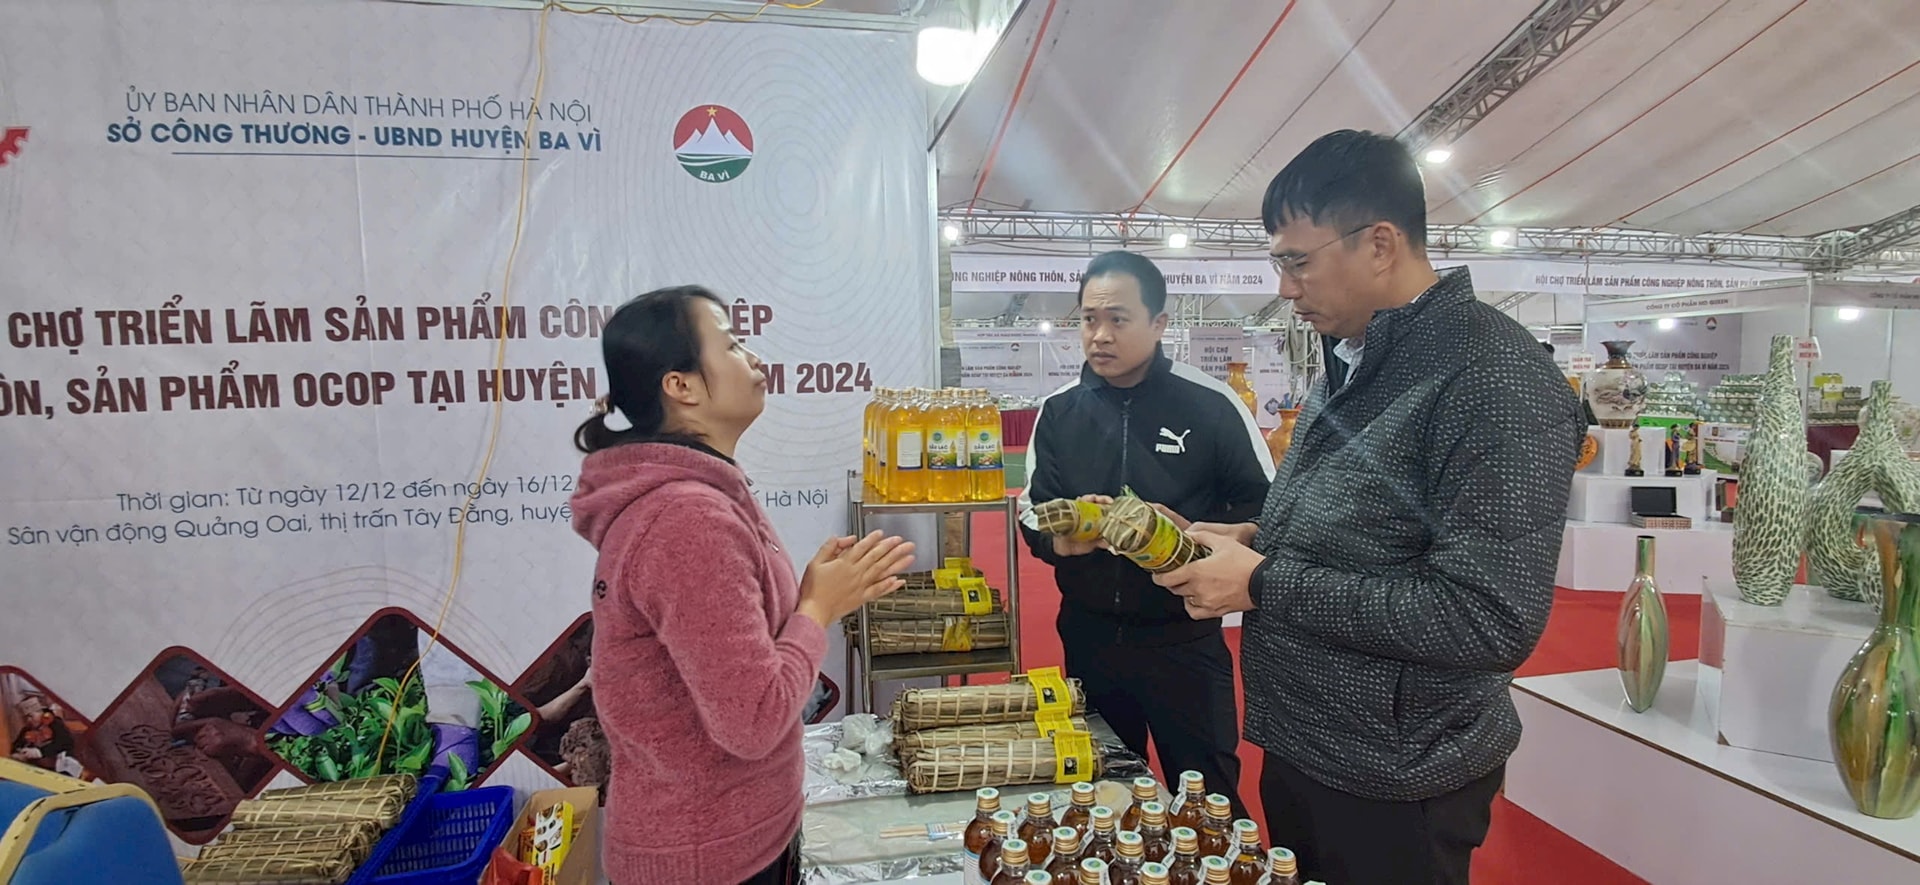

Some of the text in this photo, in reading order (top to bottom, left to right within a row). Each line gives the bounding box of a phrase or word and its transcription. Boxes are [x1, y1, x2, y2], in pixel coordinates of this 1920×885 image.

[126, 85, 591, 126] ỦY BAN NHÂN DÂN THÀNH PHỐ HÀ NỘI
[107, 116, 142, 143] SỞ
[151, 118, 233, 143] CÔNG
[241, 122, 350, 145] THƯƠNG
[374, 127, 442, 147] UBND
[451, 125, 530, 154] HUYỆN
[539, 131, 570, 150] BA
[578, 128, 602, 151] VÌ
[700, 169, 730, 181] BA VÌ
[1009, 270, 1037, 282] NÔNG
[1195, 274, 1207, 284] BA
[1242, 275, 1263, 285] 2024
[8, 307, 84, 355] CHỢ
[95, 294, 213, 345] TRIỂN
[225, 301, 311, 343] LÃM
[324, 295, 404, 342] SẢN
[416, 292, 526, 340] PHẨM
[539, 298, 614, 339] CÔN
[66, 365, 147, 414] SẢN
[159, 360, 280, 411] PHẨM
[293, 371, 395, 408] OCOP
[407, 370, 465, 411] TẠI
[478, 360, 596, 408] HUYỆN
[796, 362, 873, 393] 2024
[116, 474, 577, 514] Thời gian: Từ ngày 12/12 đến ngày 16/12
[8, 526, 50, 545] Sân
[56, 524, 99, 547] vận
[105, 522, 167, 544] động
[174, 516, 259, 539] Quảng
[266, 512, 312, 533] Oai,
[319, 511, 347, 533] thị
[353, 508, 398, 529] trấn
[404, 508, 442, 529] Tây
[522, 502, 572, 523] huyệ
[765, 490, 792, 507] Hà
[797, 489, 829, 509] Nội
